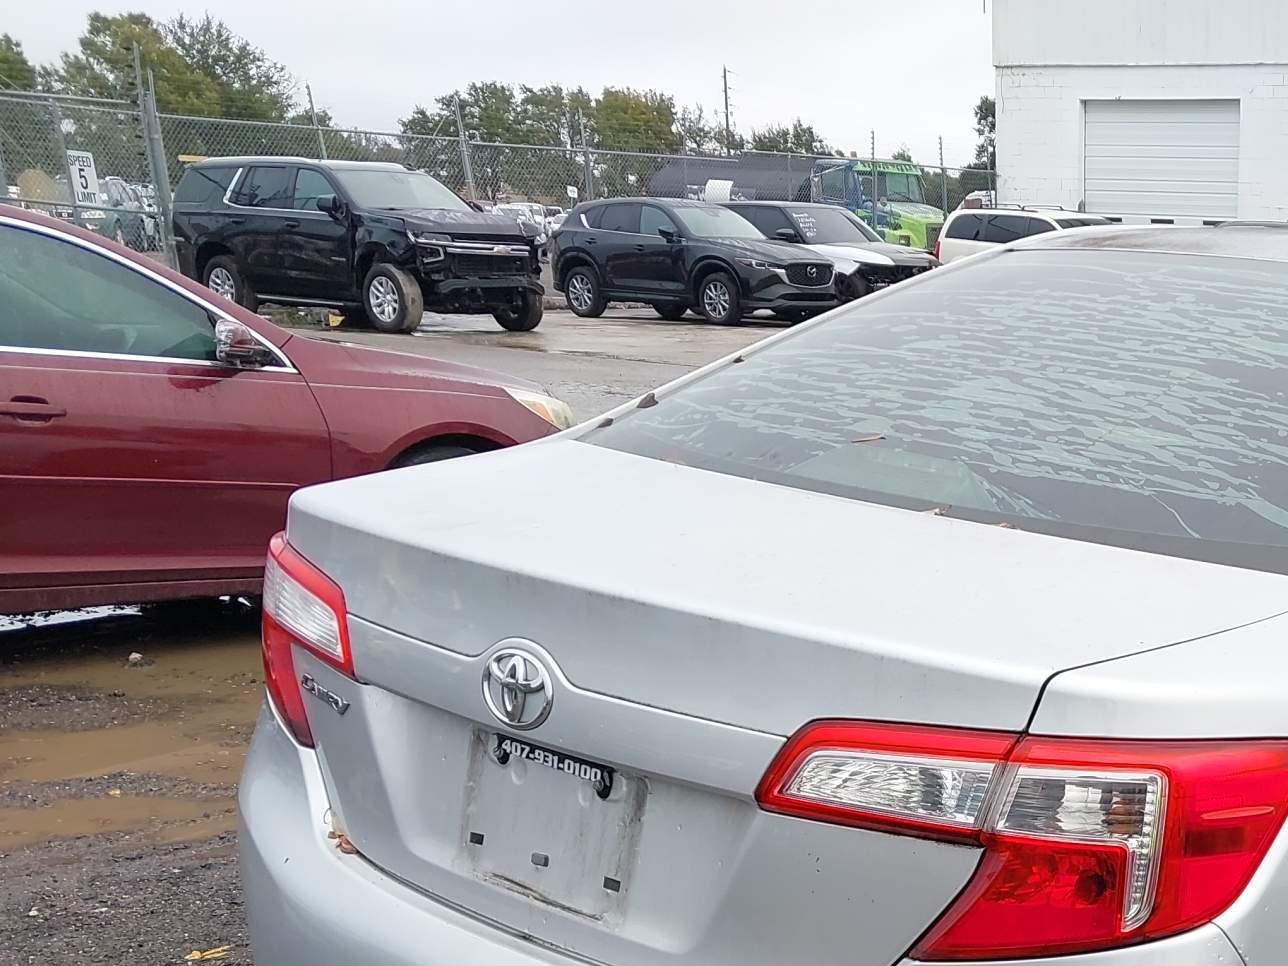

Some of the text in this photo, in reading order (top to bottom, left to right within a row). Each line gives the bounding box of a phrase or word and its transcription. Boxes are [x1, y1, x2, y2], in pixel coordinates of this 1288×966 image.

[67, 154, 92, 168] SPEED
[78, 167, 89, 190] 5
[76, 191, 97, 204] LIMIT
[501, 739, 602, 782] 407-931-0100
